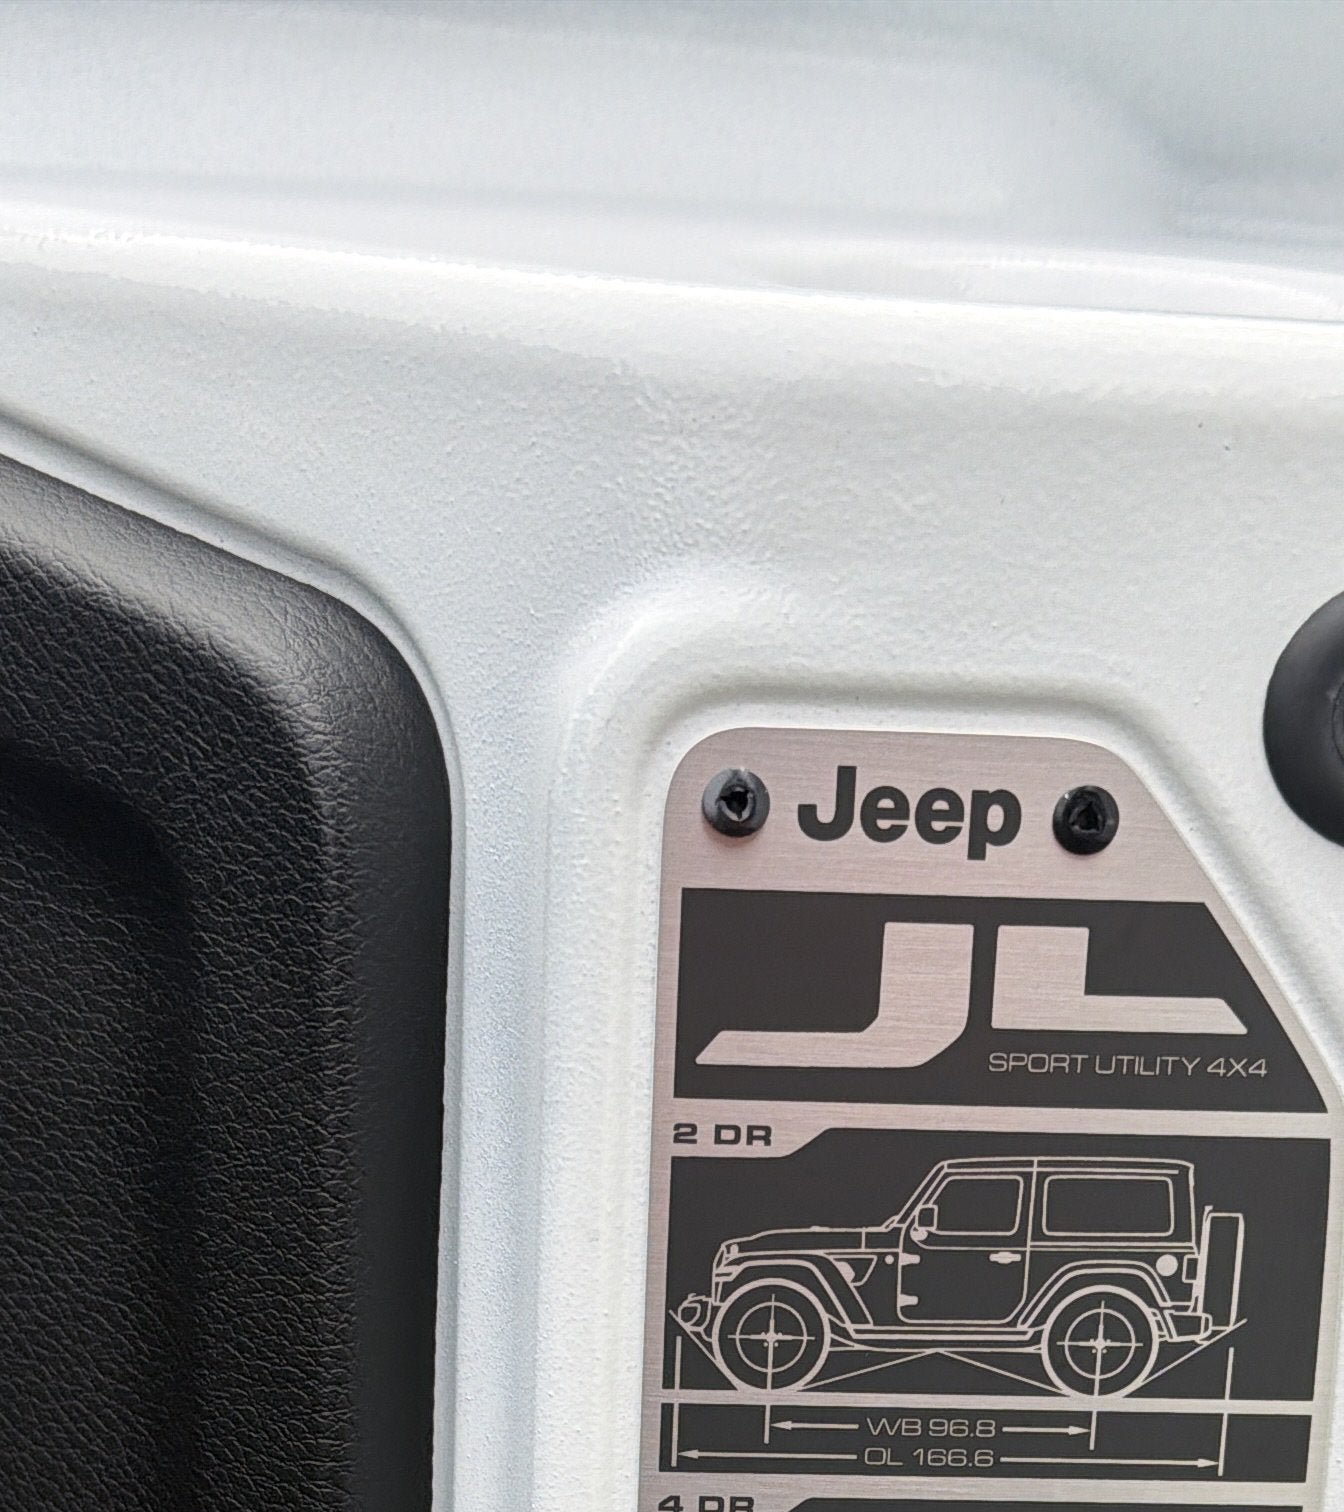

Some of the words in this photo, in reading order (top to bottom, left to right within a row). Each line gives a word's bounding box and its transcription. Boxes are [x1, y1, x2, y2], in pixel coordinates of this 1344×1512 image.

[798, 765, 1022, 860] Jeep
[695, 921, 1248, 1068] JL
[988, 1052, 1088, 1074] SPORT
[1095, 1054, 1201, 1077] UTILITY
[1206, 1056, 1268, 1078] 4X4
[672, 1122, 698, 1144] 2
[714, 1124, 772, 1147] DR
[867, 1416, 922, 1437] WB
[929, 1417, 996, 1439] 96.8
[864, 1447, 904, 1467] OL
[913, 1448, 994, 1468] 166.6
